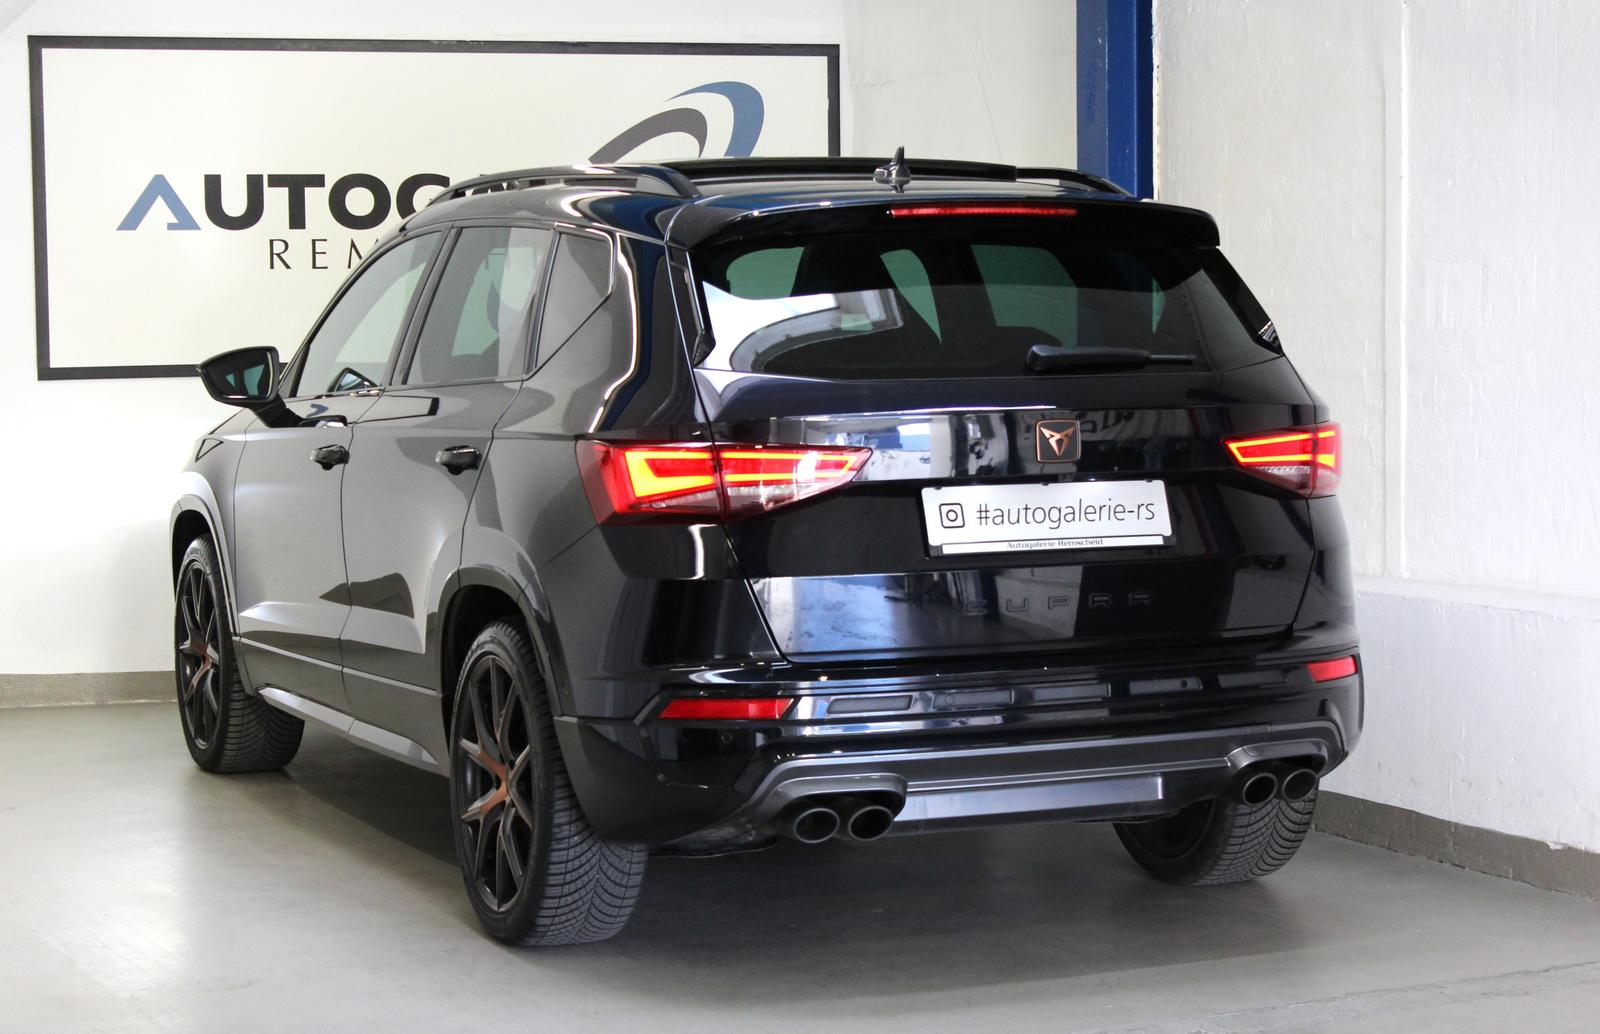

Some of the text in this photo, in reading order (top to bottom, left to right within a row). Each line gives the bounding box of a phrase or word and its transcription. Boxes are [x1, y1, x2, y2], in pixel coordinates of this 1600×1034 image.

[976, 498, 1155, 530] #autogalerie-rs
[1006, 538, 1104, 550] Autogalerie Remscheid
